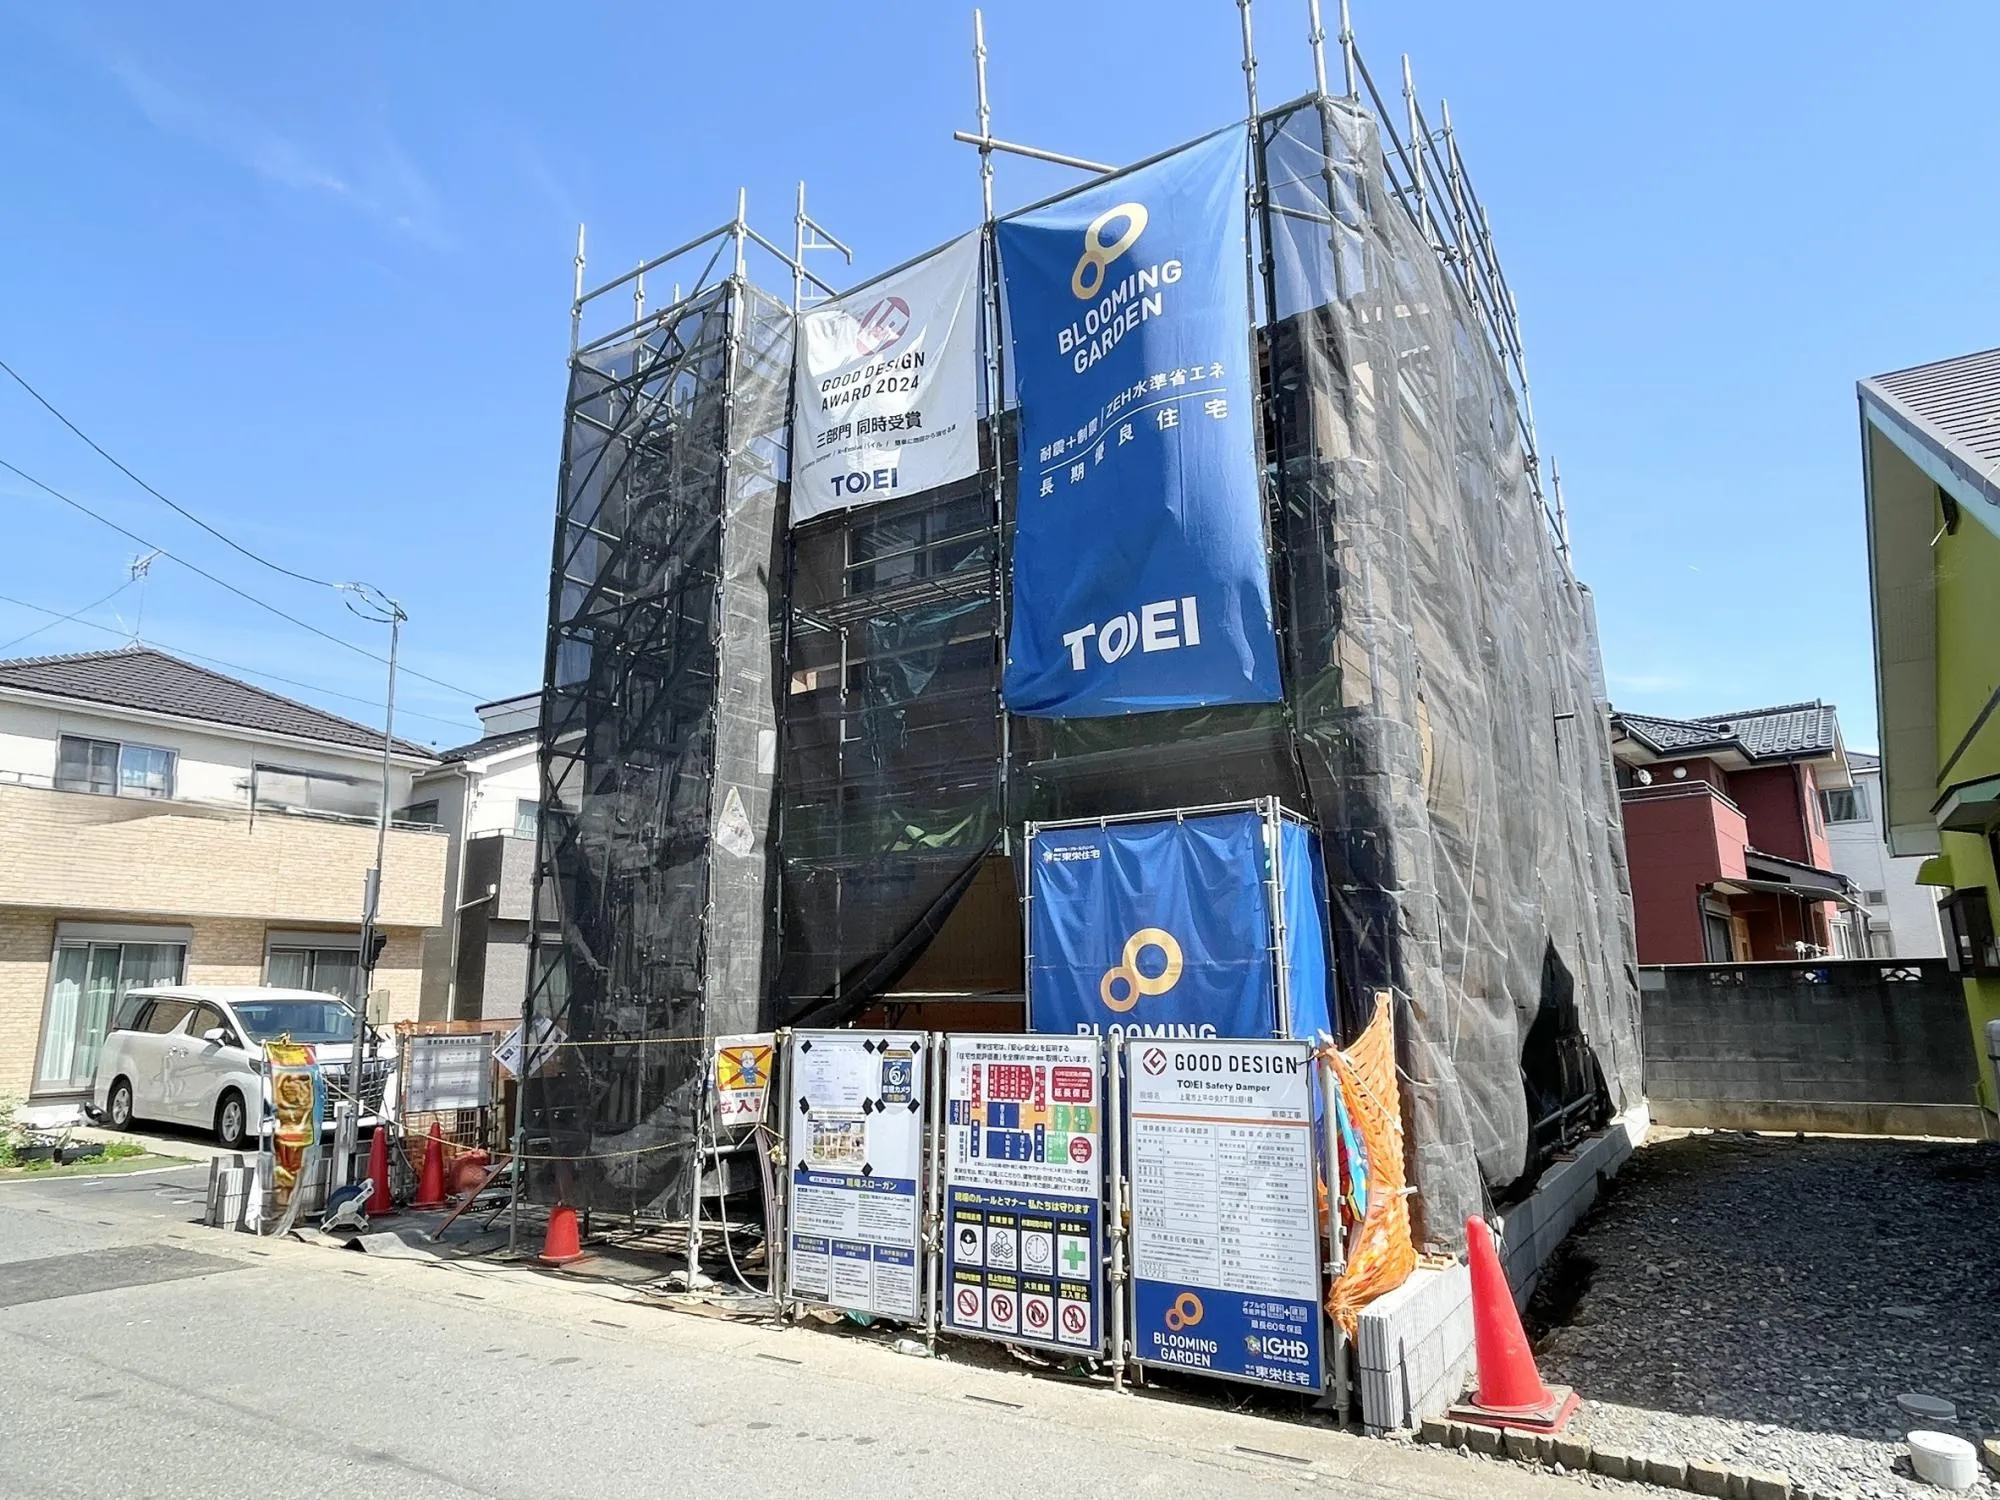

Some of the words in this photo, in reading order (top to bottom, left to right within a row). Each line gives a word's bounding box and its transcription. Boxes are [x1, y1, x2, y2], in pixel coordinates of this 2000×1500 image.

[1058, 259, 1182, 355] BLOOMING
[1074, 292, 1162, 374] GARDEN
[821, 370, 861, 392] GOOD
[864, 351, 925, 379] DESIGN
[821, 383, 872, 413] AWARD
[876, 375, 919, 394] 2024
[816, 423, 852, 449] 三部門
[856, 410, 923, 437] 同時受賞
[1062, 595, 1201, 671] TOEI
[1175, 1053, 1222, 1072] GOOD
[1228, 1055, 1298, 1075] DESIGN
[1205, 1081, 1234, 1092] Safety
[1235, 1083, 1271, 1093] Damper
[1027, 1199, 1090, 1214] 私たちは守ります
[1153, 1331, 1218, 1354] BLOOMING
[1262, 1335, 1309, 1359] IGHD
[1160, 1346, 1211, 1368] GARDEN
[1255, 1365, 1310, 1386] 東栄住宅
